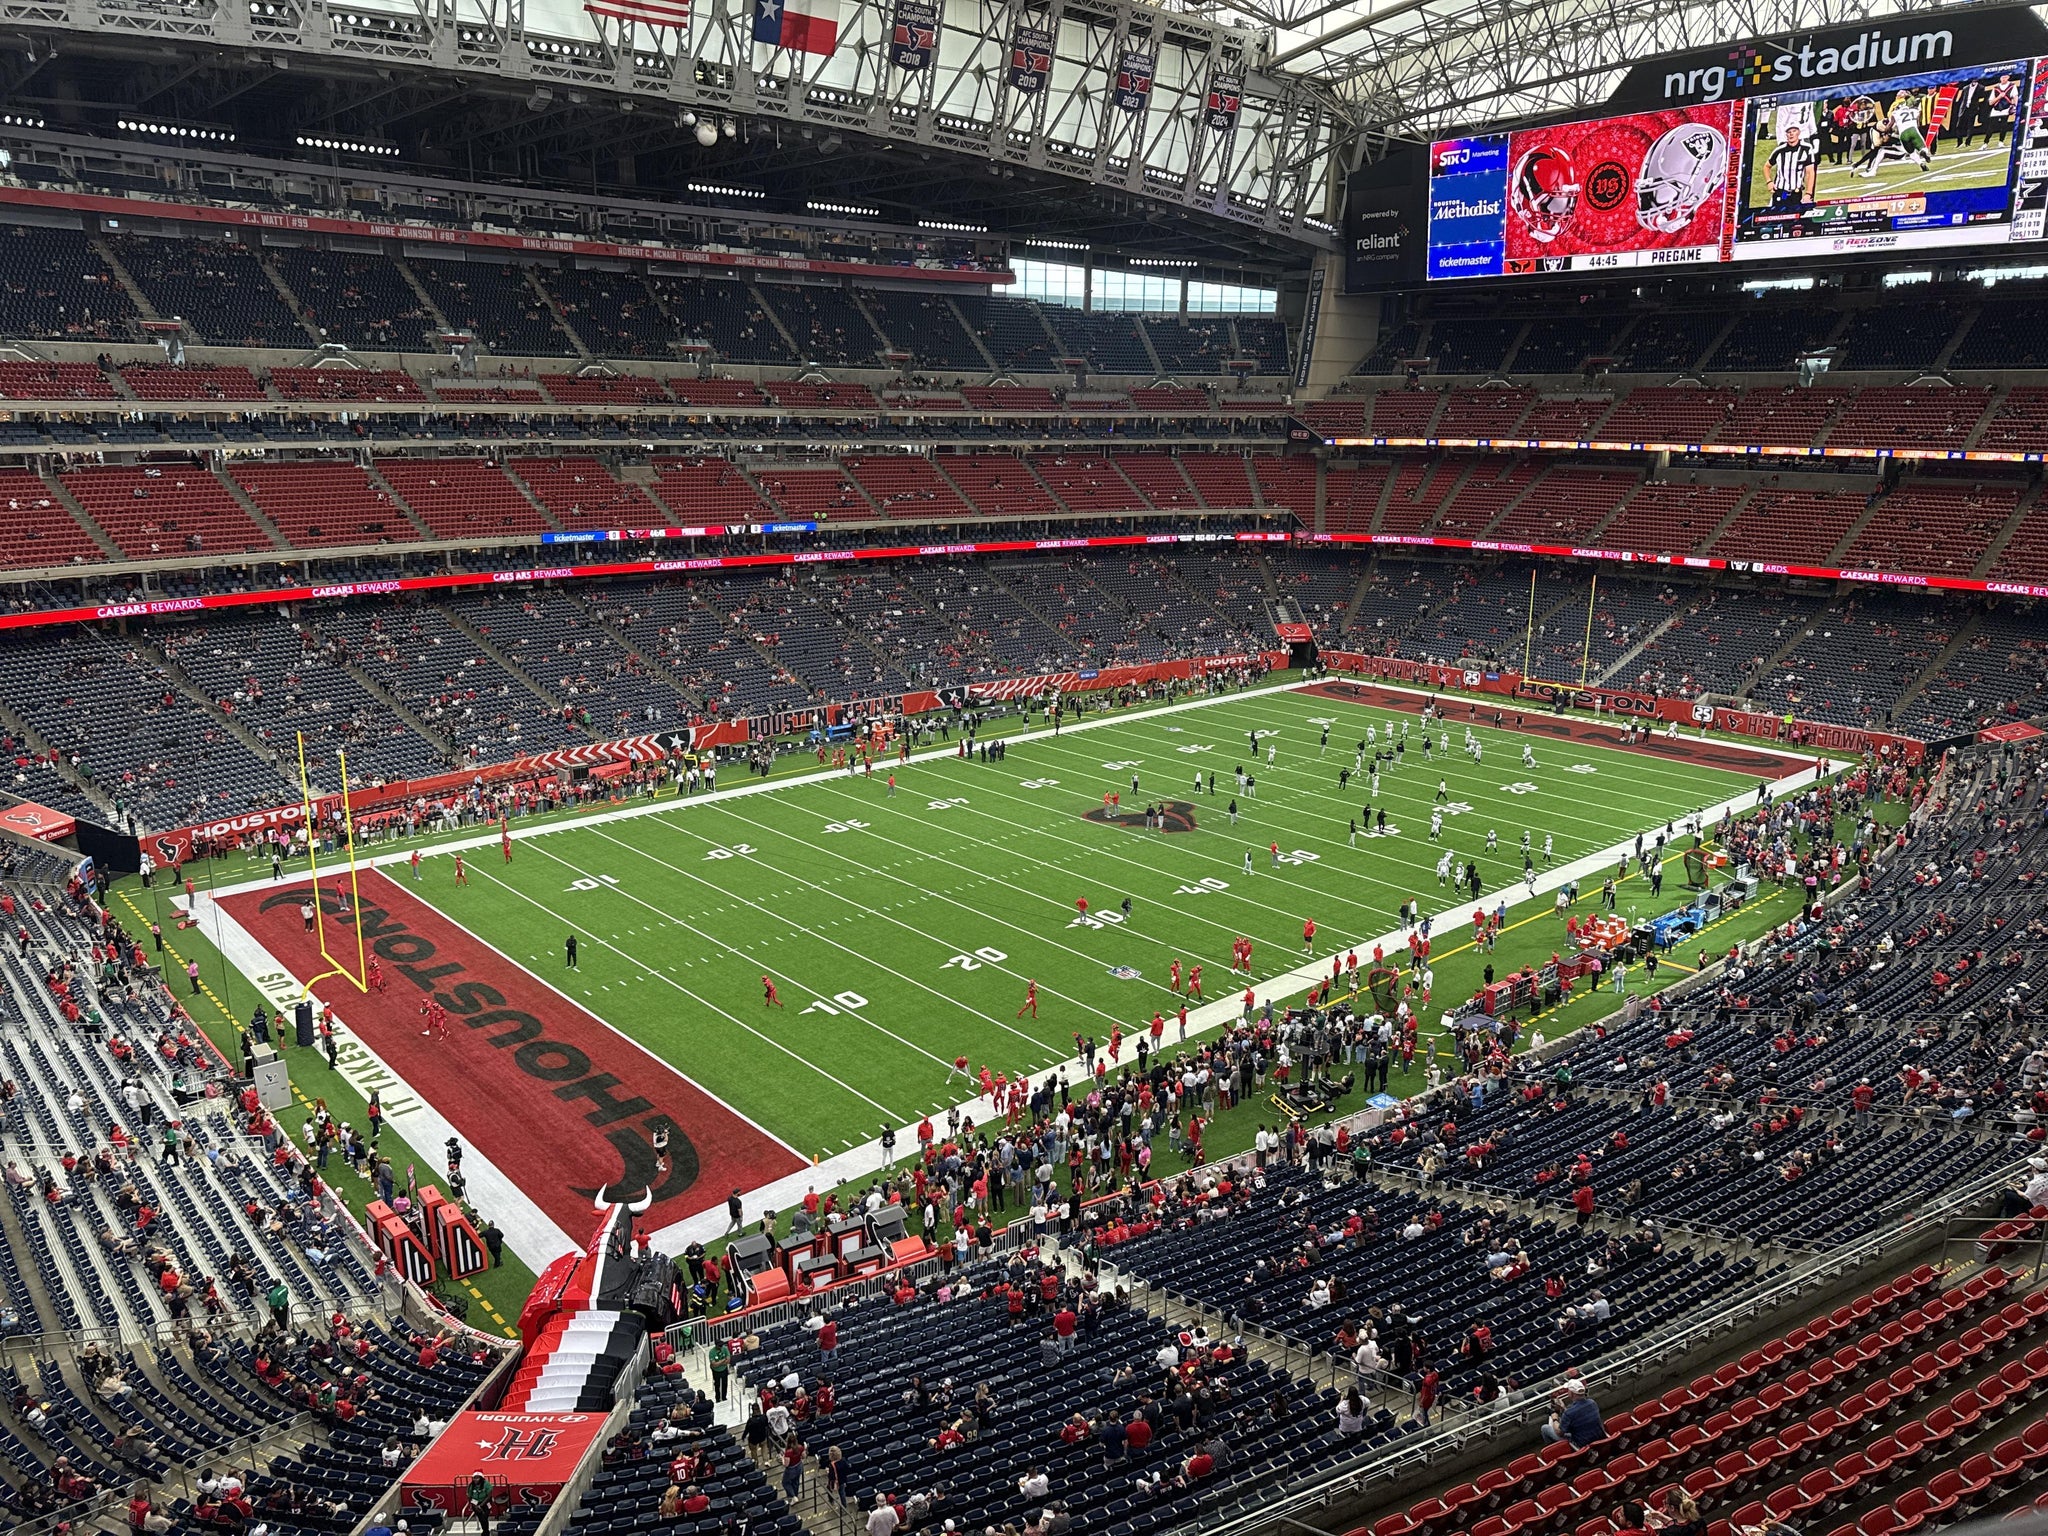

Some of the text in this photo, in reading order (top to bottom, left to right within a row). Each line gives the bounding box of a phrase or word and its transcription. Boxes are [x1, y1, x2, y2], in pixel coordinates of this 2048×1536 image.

[903, 4, 932, 16] AFC SOUTH
[898, 11, 935, 24] CHAMPIONS
[1017, 36, 1051, 49] CHAMPIONS
[1022, 31, 1049, 41] AFC SOUTH
[899, 51, 921, 65] 2018
[1136, 56, 1149, 65] SOUTH
[1123, 60, 1152, 72] CHAMPIONS
[1664, 30, 1953, 101] nrg stadium
[1018, 74, 1037, 87] 2019
[1213, 81, 1240, 92] CHAMPIONS
[1226, 76, 1239, 85] SOUTH
[1122, 95, 1139, 107] 2023
[1211, 114, 1228, 126] 2024
[1732, 101, 1745, 139] TEXANS
[1899, 111, 1918, 123] 21
[1472, 149, 1499, 158] Marketing
[1727, 149, 1741, 188] HOUSTON
[1434, 199, 1460, 207] HOUSTON
[1724, 190, 1738, 225] TEXANS
[1835, 202, 1905, 216] 6 19
[1362, 209, 1399, 221] powered by
[1433, 200, 1500, 221] Methodist
[243, 214, 308, 228] J.J. WATT #99
[370, 225, 455, 241] ANDRE JOHNSON #80
[523, 238, 541, 248] RING
[549, 240, 574, 251] HONOR
[1356, 232, 1400, 251] reliant
[1846, 236, 1898, 246] REDZONE
[618, 246, 643, 257] ROBERT
[653, 249, 677, 259] MCNAIR
[682, 251, 710, 262] FOUNDER
[1721, 234, 1733, 262] HOUST
[734, 255, 810, 269] JANICE MCNAIR FOUNDER
[1376, 253, 1400, 262] company
[1439, 255, 1493, 268] ticketmaster
[1589, 249, 1702, 266] 44:45 PREGAME
[772, 523, 808, 532] ticketmaster
[554, 532, 595, 543] ticketmaster
[1036, 538, 1089, 549] CAESARS REWARDS
[1146, 535, 1170, 543] CAESARS
[1372, 535, 1434, 545] CAESARS REWARDS
[919, 544, 976, 555] CAESARS REWARDS
[1471, 540, 1531, 552] CAESARS REWARDS
[794, 551, 855, 562] CAESARS REWARDS
[1572, 549, 1602, 558] CAESARS
[654, 559, 722, 570] CAESARS REWARDS
[493, 567, 574, 582] CAESARS REWARDS
[1840, 571, 1928, 586] CAESARS REWARDS
[312, 581, 401, 598] CAESARS REWARDS
[1986, 582, 2030, 595] CAESARS
[97, 599, 203, 619] CAESARS REWARDS
[1519, 681, 1657, 714] HOSTON
[1695, 706, 1711, 719] 25
[748, 706, 828, 740] HOUSTON
[1747, 717, 1773, 735] H'S
[192, 803, 318, 839] HOUSTON
[823, 818, 871, 834] 30
[47, 827, 69, 839] Chevron
[708, 843, 758, 862] 20
[1278, 849, 1321, 866] 50
[571, 874, 620, 892] 10
[1178, 877, 1230, 896] 40
[947, 946, 1008, 972] 20
[256, 972, 295, 992] US
[814, 990, 869, 1016] 10
[337, 897, 657, 1126] HOUSTON
[336, 1041, 398, 1098] TAKES
[380, 1096, 423, 1118] IT
[475, 1414, 554, 1423] HYUNDAI
[966, 1430, 978, 1442] 99
[676, 1469, 686, 1481] 10
